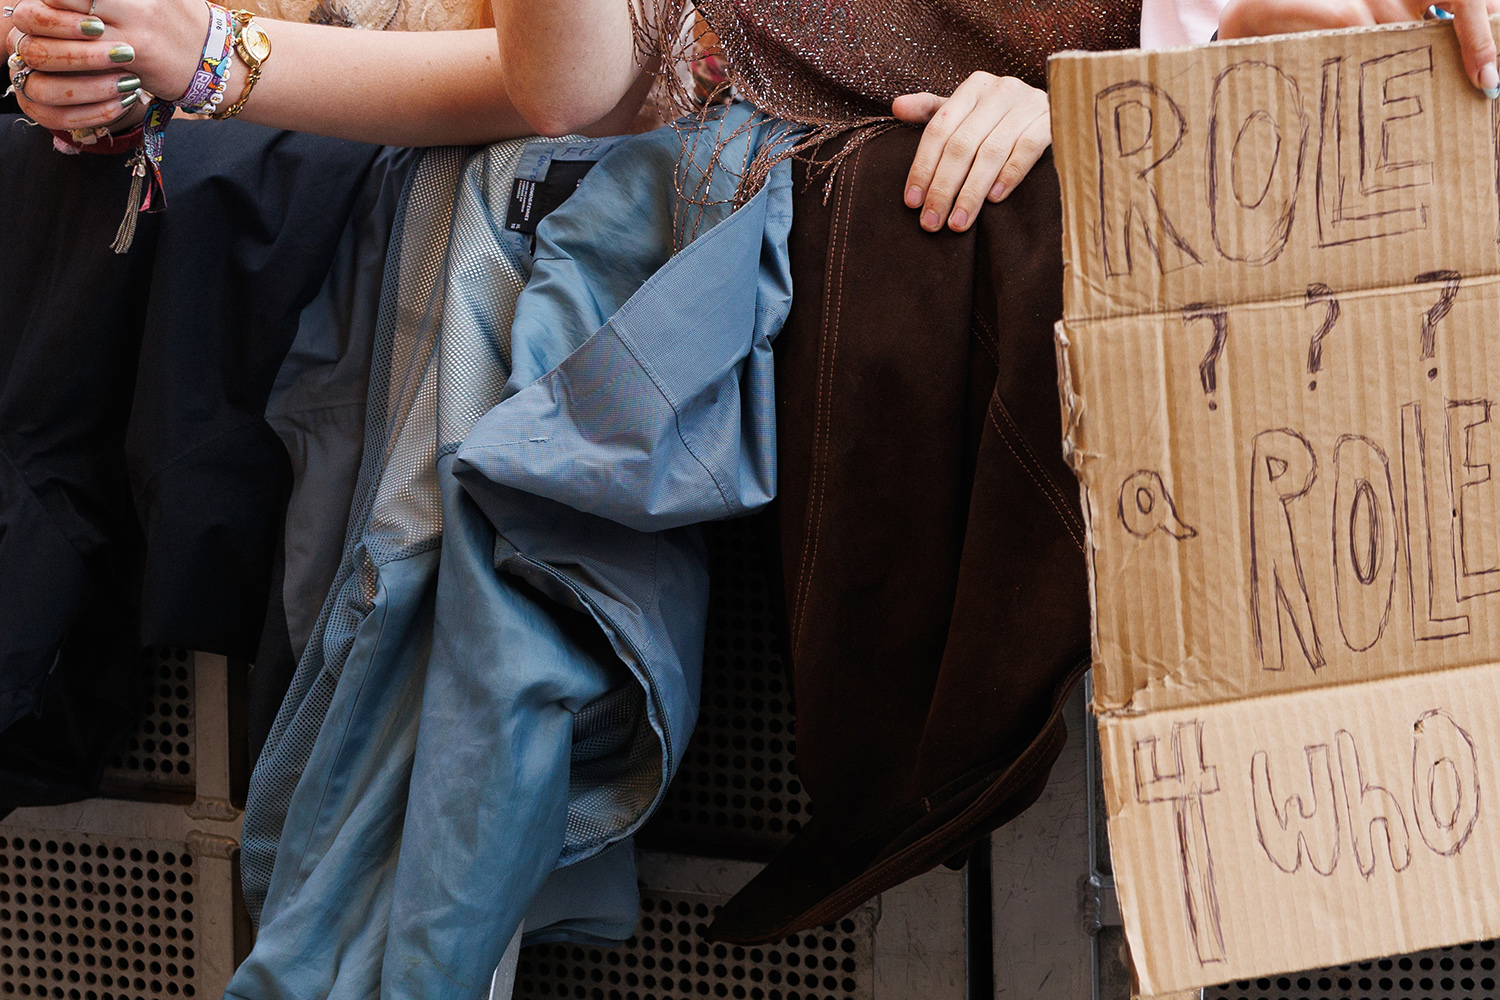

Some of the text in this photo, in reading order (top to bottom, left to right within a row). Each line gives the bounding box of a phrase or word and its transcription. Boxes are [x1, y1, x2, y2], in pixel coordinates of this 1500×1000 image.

[215, 17, 224, 31] 106
[1093, 44, 1435, 278] ROLE
[1117, 468, 1198, 542] a
